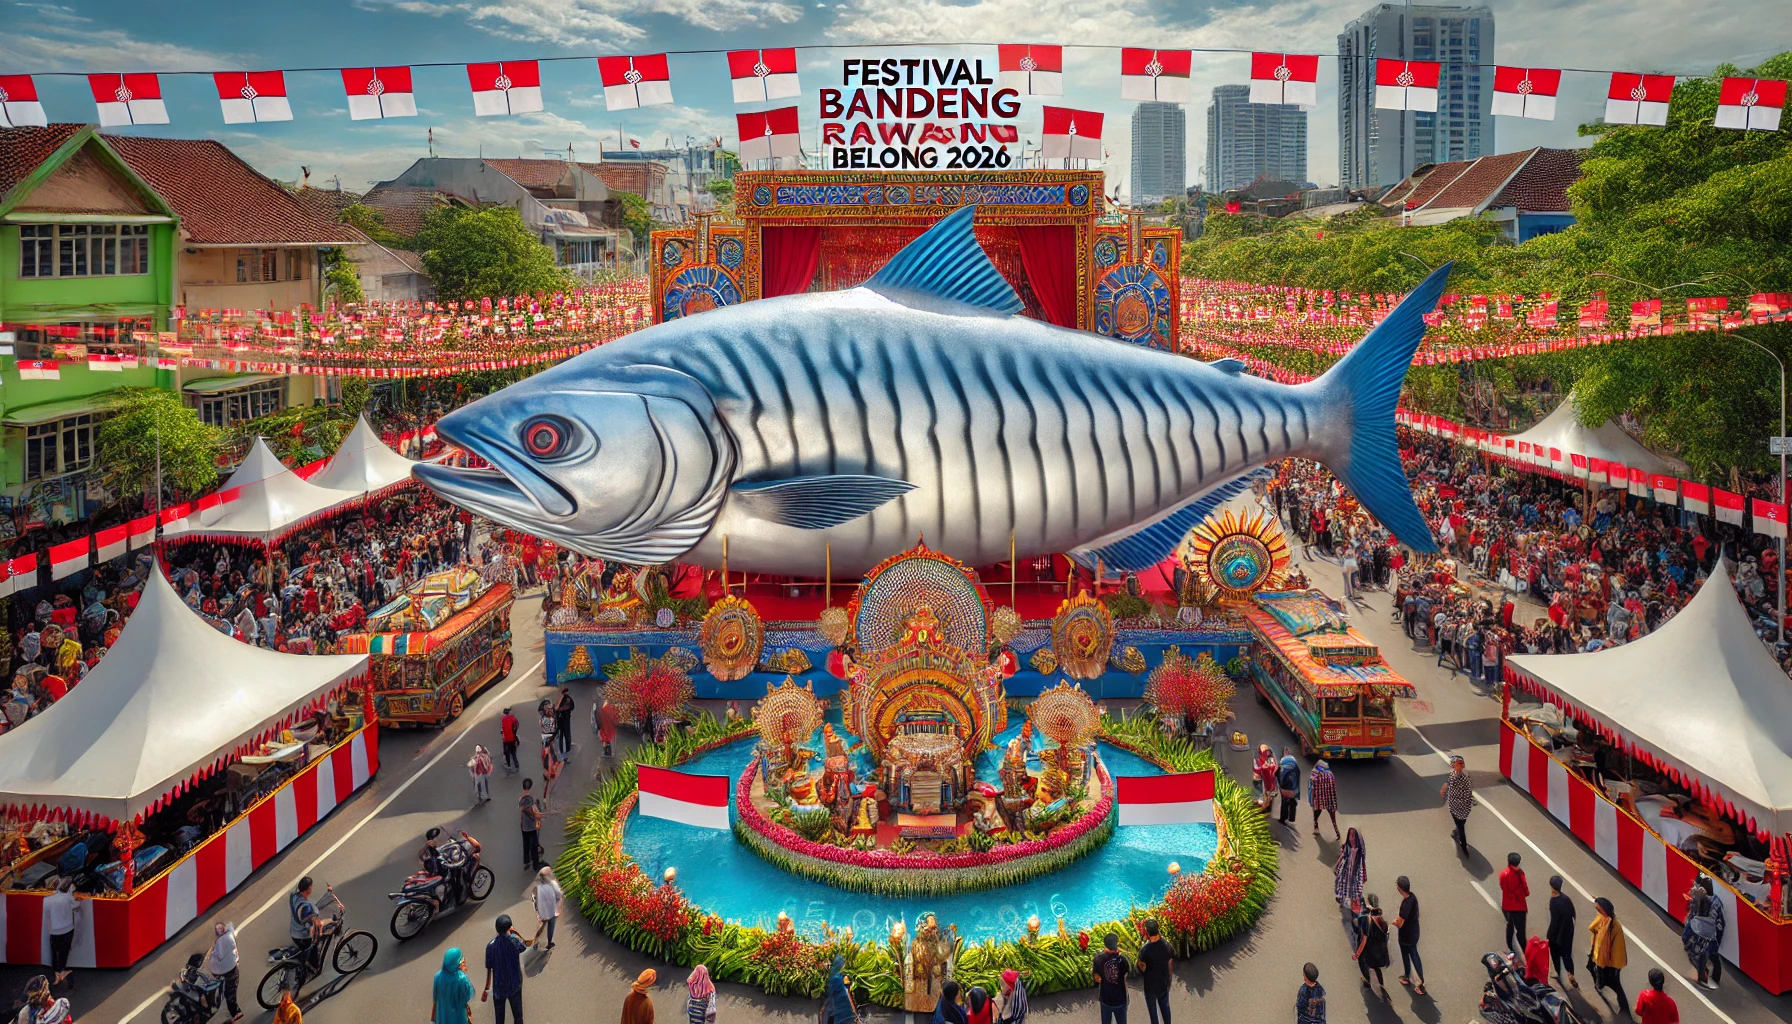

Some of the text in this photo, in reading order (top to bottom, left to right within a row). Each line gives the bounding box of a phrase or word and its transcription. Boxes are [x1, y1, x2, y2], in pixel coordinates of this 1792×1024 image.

[843, 58, 994, 86] FESTIVAL
[819, 88, 1021, 120] BANDENG
[832, 145, 1012, 169] BELONG 2026
